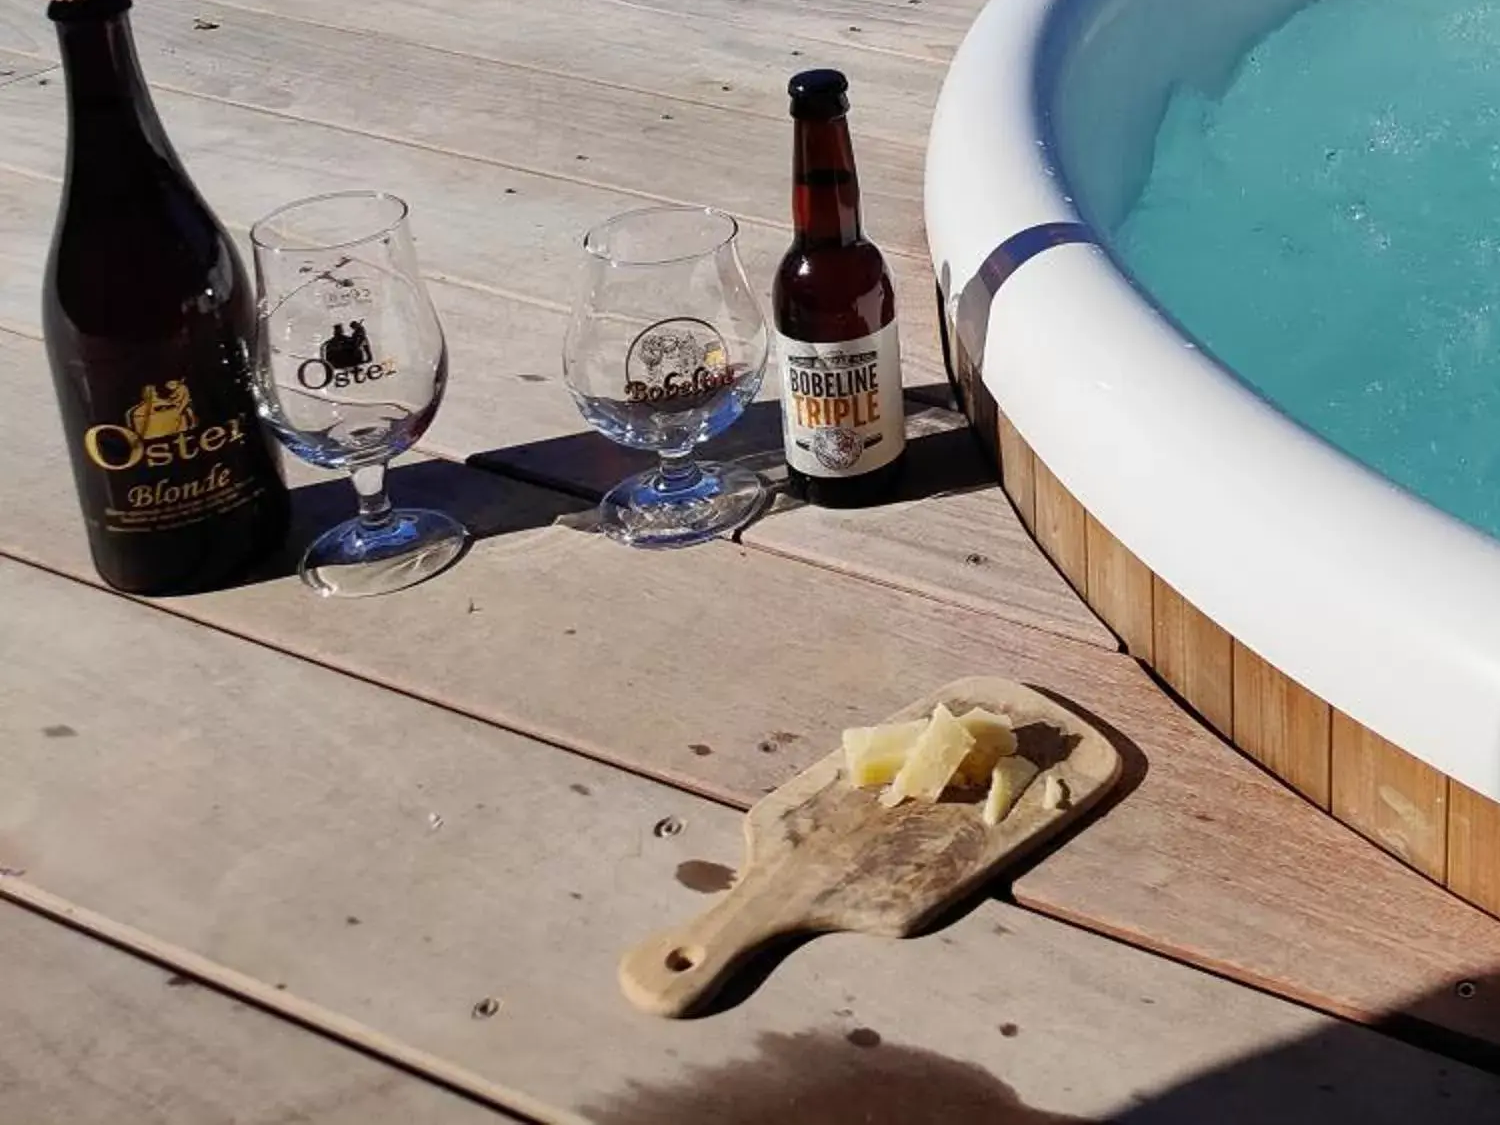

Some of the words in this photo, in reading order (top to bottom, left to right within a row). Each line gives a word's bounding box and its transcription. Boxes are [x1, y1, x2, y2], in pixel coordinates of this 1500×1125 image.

[297, 357, 398, 390] Oster
[790, 363, 878, 397] BOBELINE
[792, 390, 880, 429] TRIPLE
[85, 413, 246, 470] Oster
[128, 463, 232, 507] Blonde
